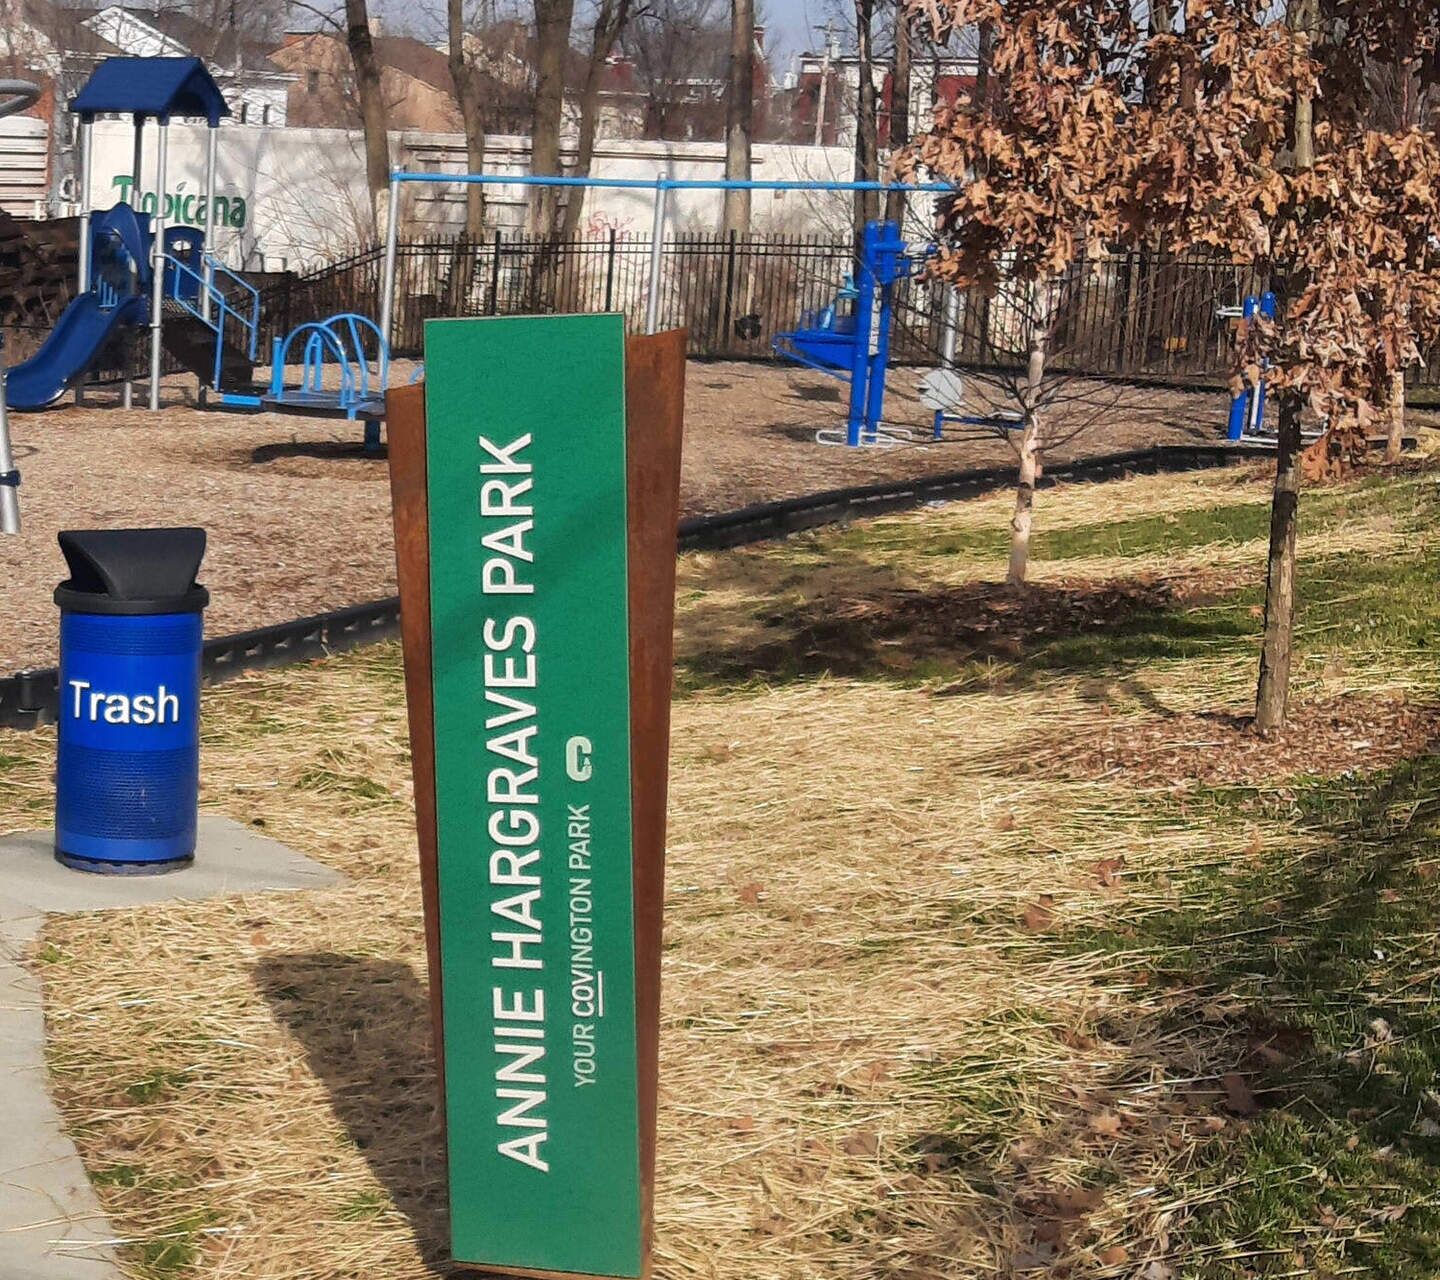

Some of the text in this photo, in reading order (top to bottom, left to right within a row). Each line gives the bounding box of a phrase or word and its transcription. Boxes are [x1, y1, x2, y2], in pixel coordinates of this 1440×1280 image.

[68, 680, 179, 725] Trash
[478, 432, 550, 1173] ANNIE HARGRAVES PARK
[567, 803, 597, 1088] YOUR COVINGTON PARK
